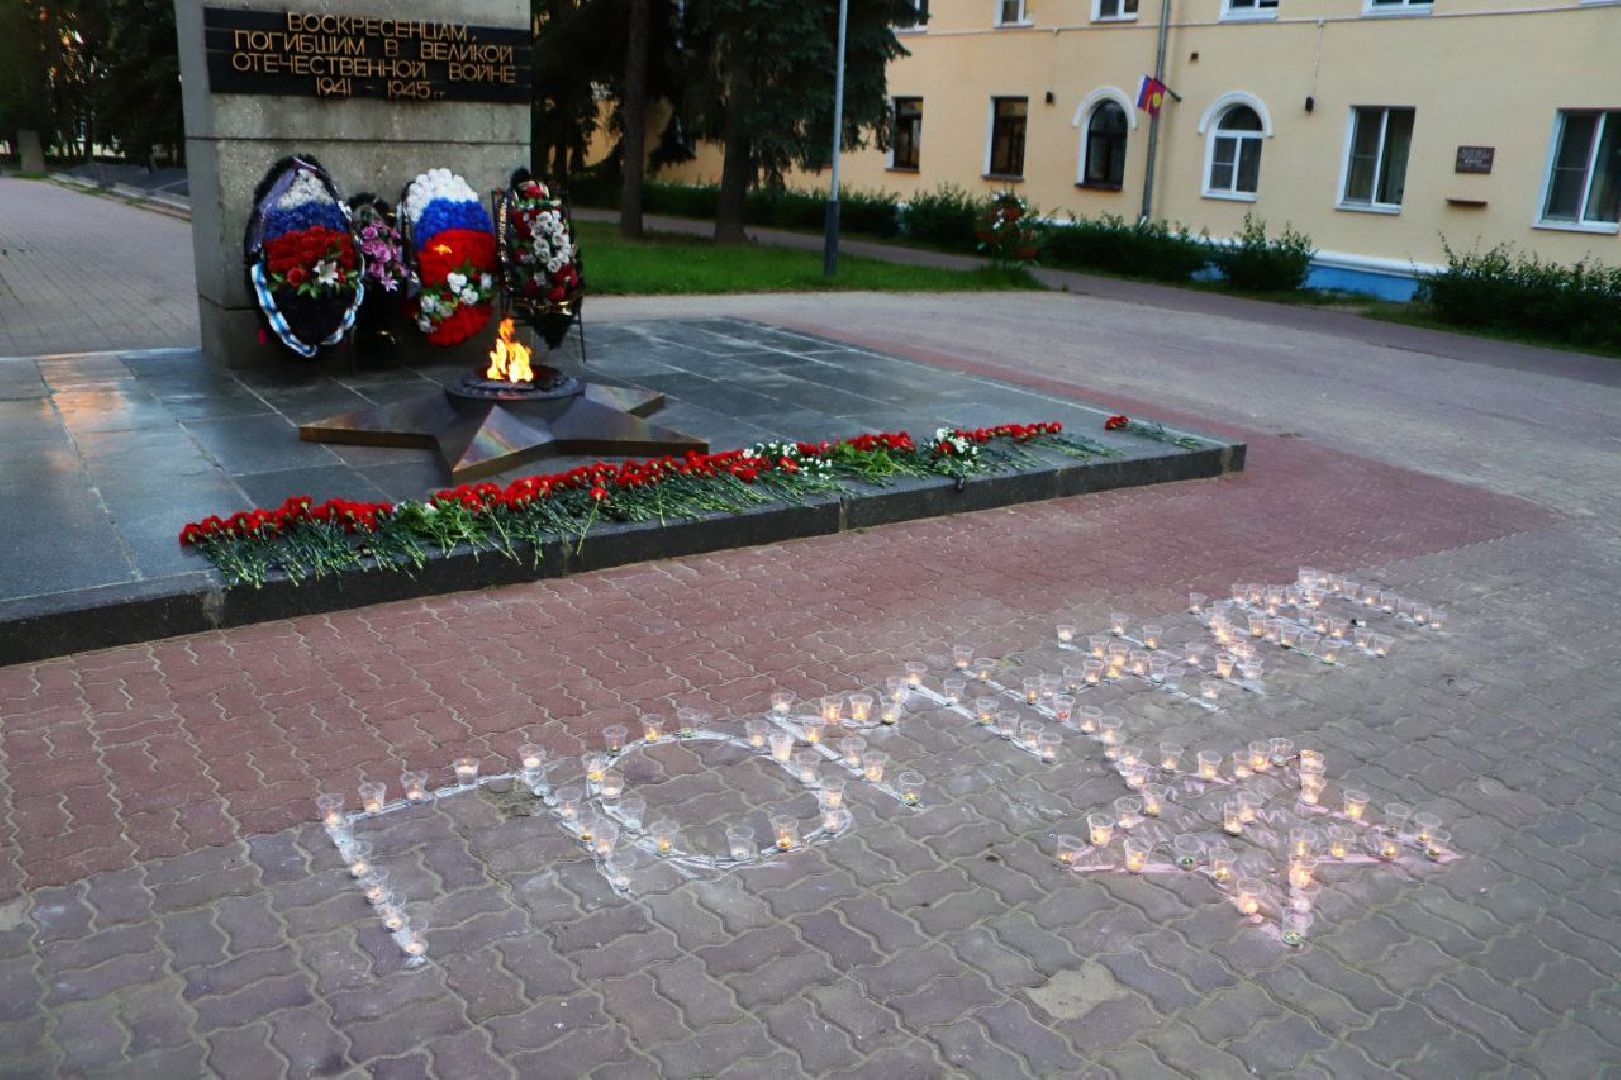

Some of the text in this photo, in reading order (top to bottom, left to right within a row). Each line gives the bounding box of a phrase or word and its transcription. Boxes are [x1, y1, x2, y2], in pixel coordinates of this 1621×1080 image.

[233, 30, 514, 64] ПОГИБШИМ В ВЕЛИКОЙ
[232, 52, 517, 84] ОТЕЧЕСТВЕННОЙ ВОЙНЕ
[315, 76, 352, 97] 1941
